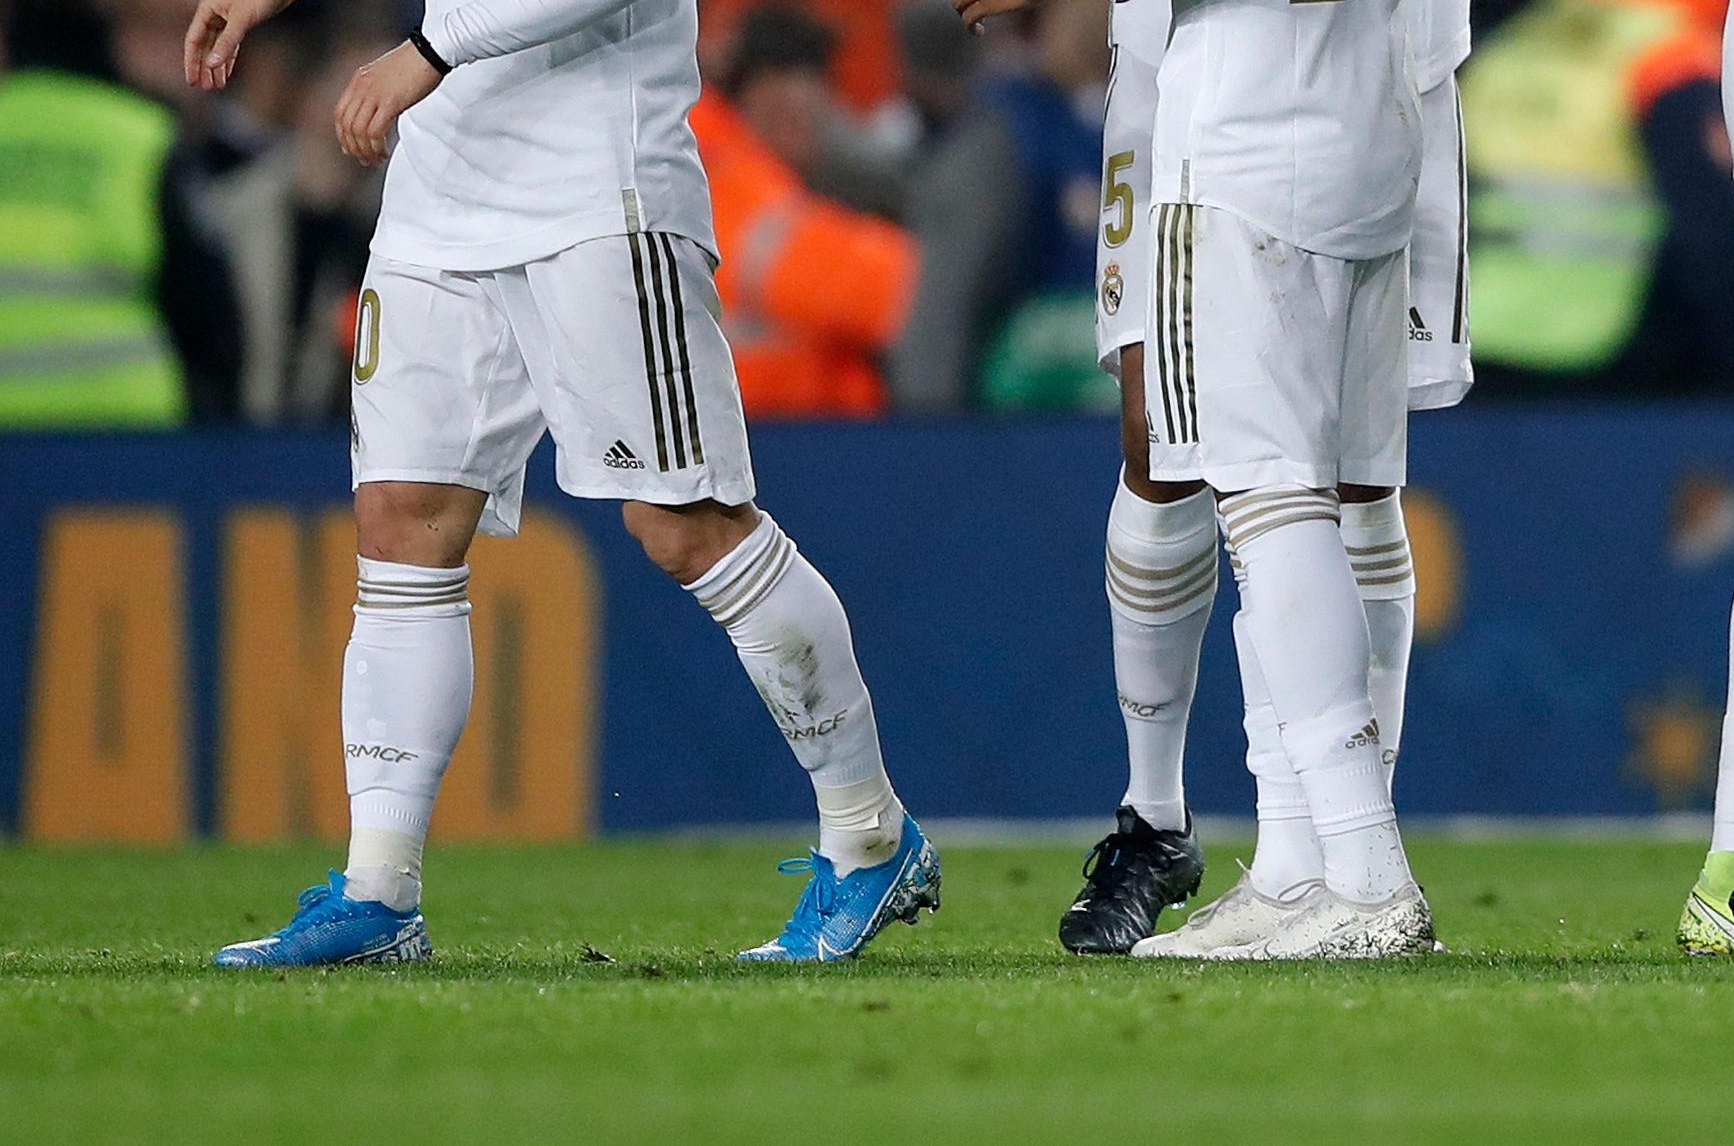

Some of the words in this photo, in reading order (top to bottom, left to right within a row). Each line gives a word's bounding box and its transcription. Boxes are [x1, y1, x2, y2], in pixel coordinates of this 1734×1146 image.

[1102, 149, 1135, 250] 5
[353, 287, 381, 386] 0
[602, 457, 646, 470] adidas
[345, 742, 420, 764] RMCF
